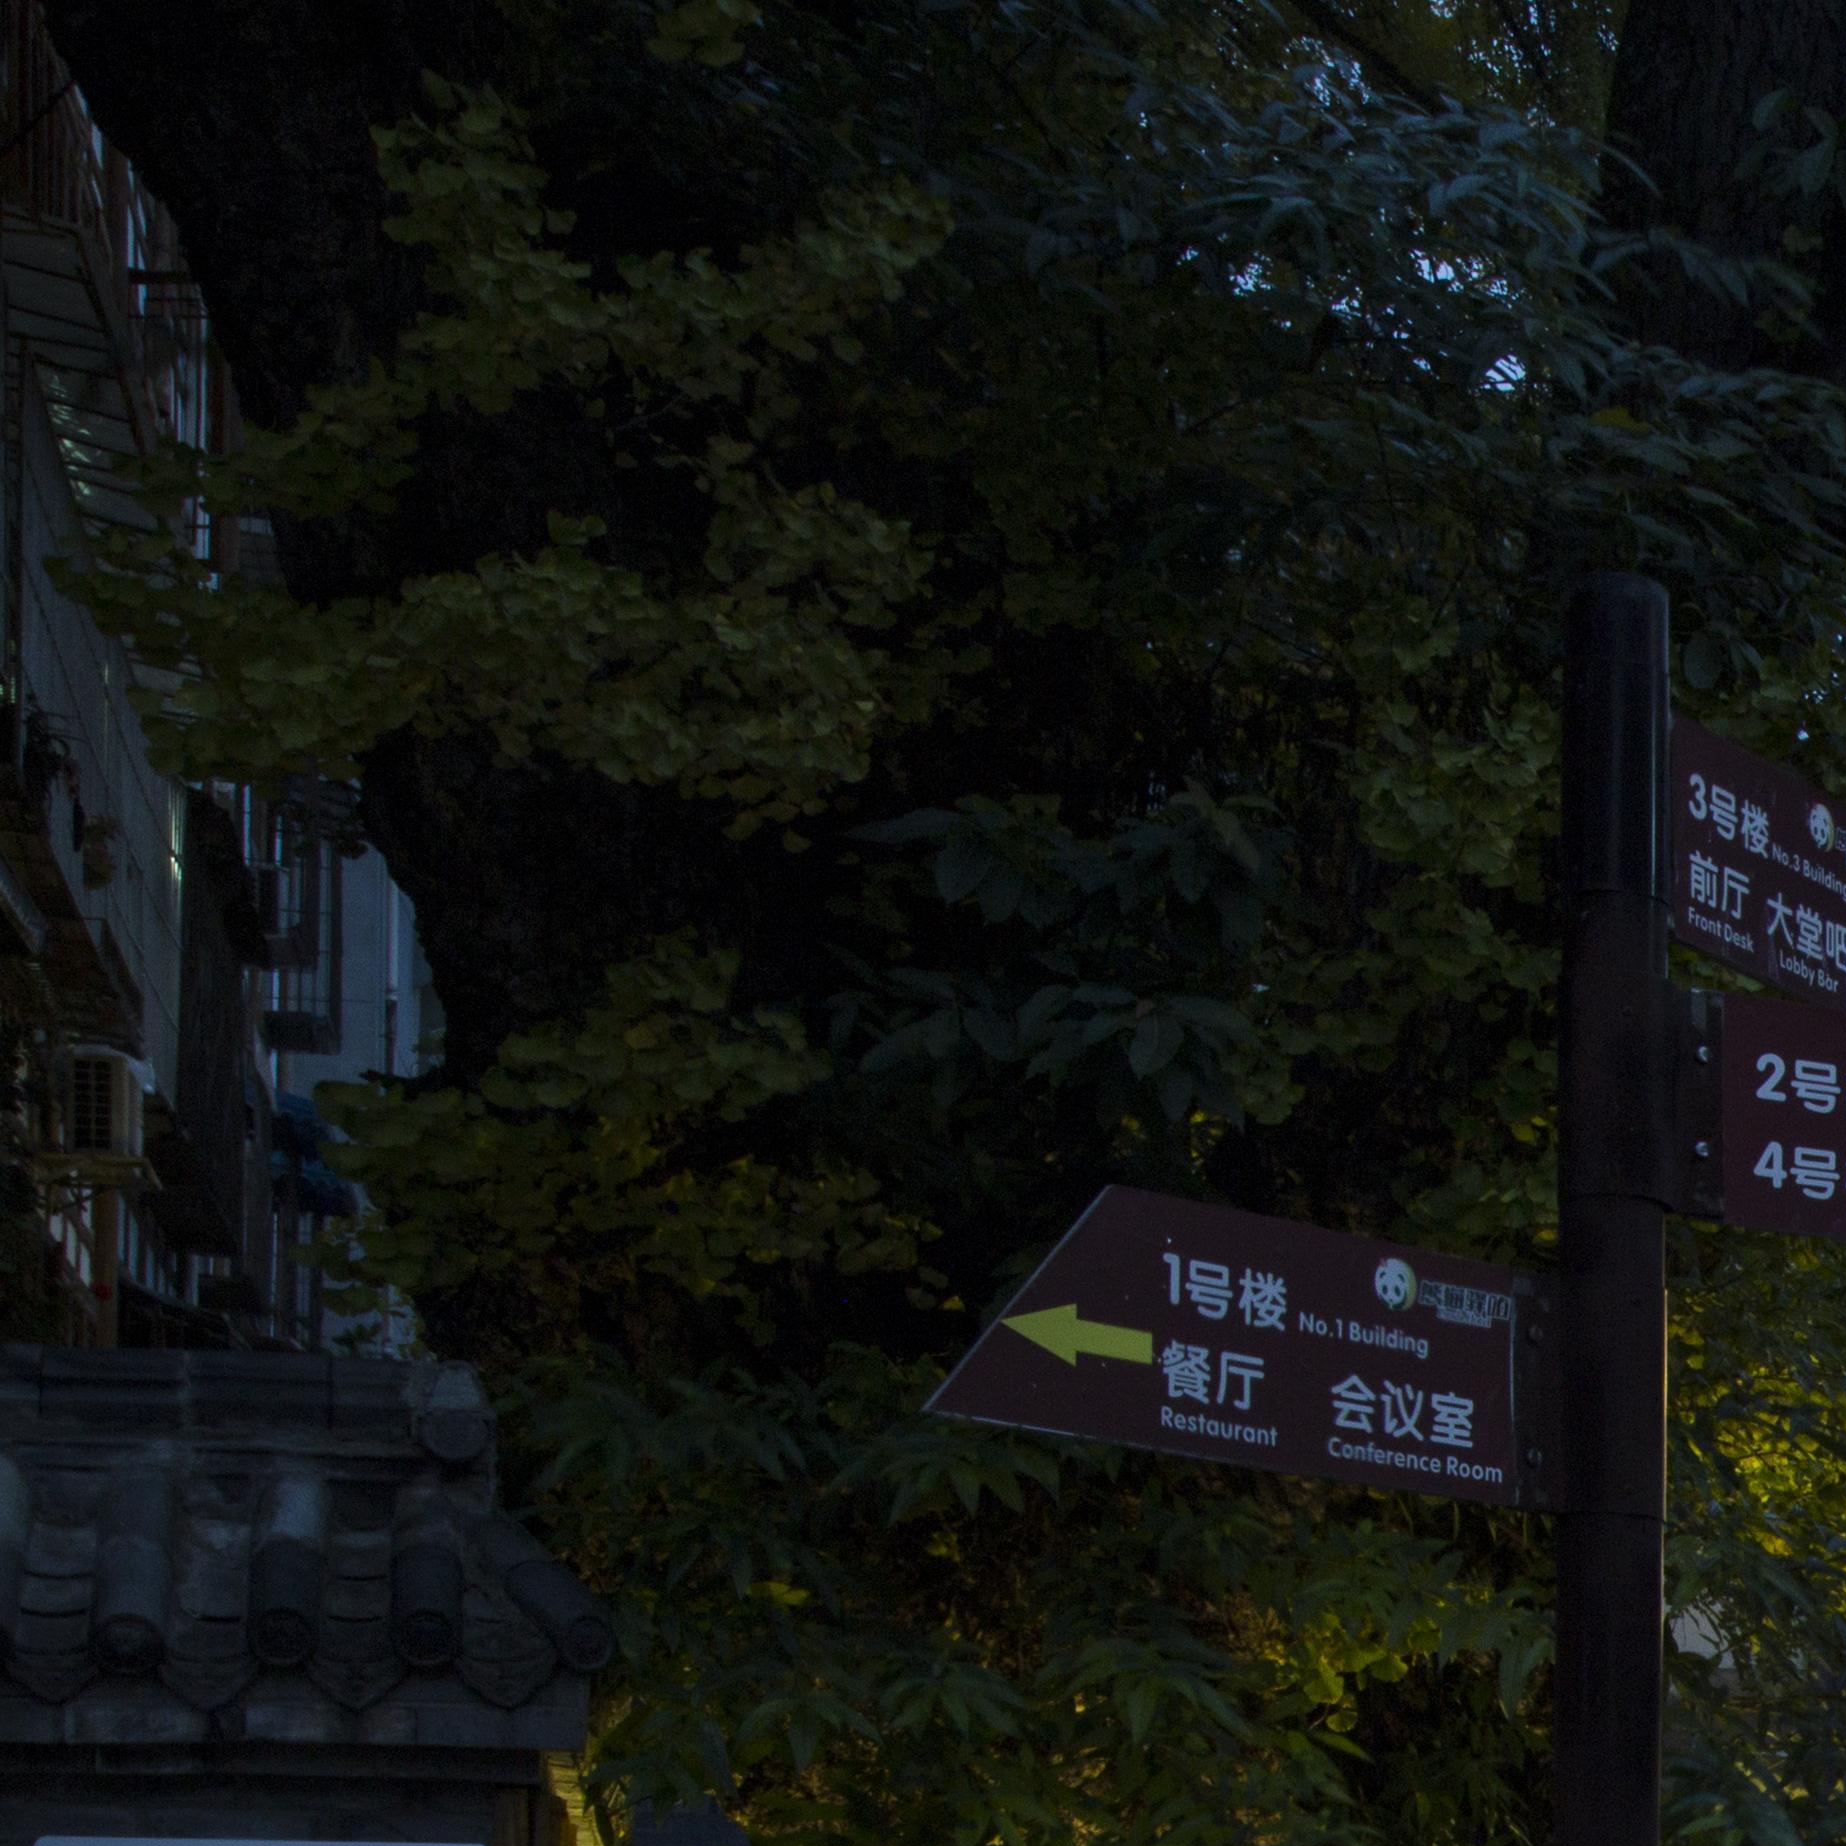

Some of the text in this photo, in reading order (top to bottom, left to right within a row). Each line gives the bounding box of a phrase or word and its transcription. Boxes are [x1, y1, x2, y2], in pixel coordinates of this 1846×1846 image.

[1689, 773, 1769, 858] 3号楼
[1772, 842, 1800, 873] No.3
[1689, 850, 1751, 920] 前厅
[1688, 906, 1754, 953] Front Desk
[1780, 950, 1840, 993] Lobby Bar
[1162, 1251, 1430, 1360] 1号楼 No.1 Building
[1161, 1339, 1475, 1449] 餐厅 会议室
[1160, 1404, 1278, 1448] Restaurant
[1328, 1436, 1503, 1484] Conference Room
